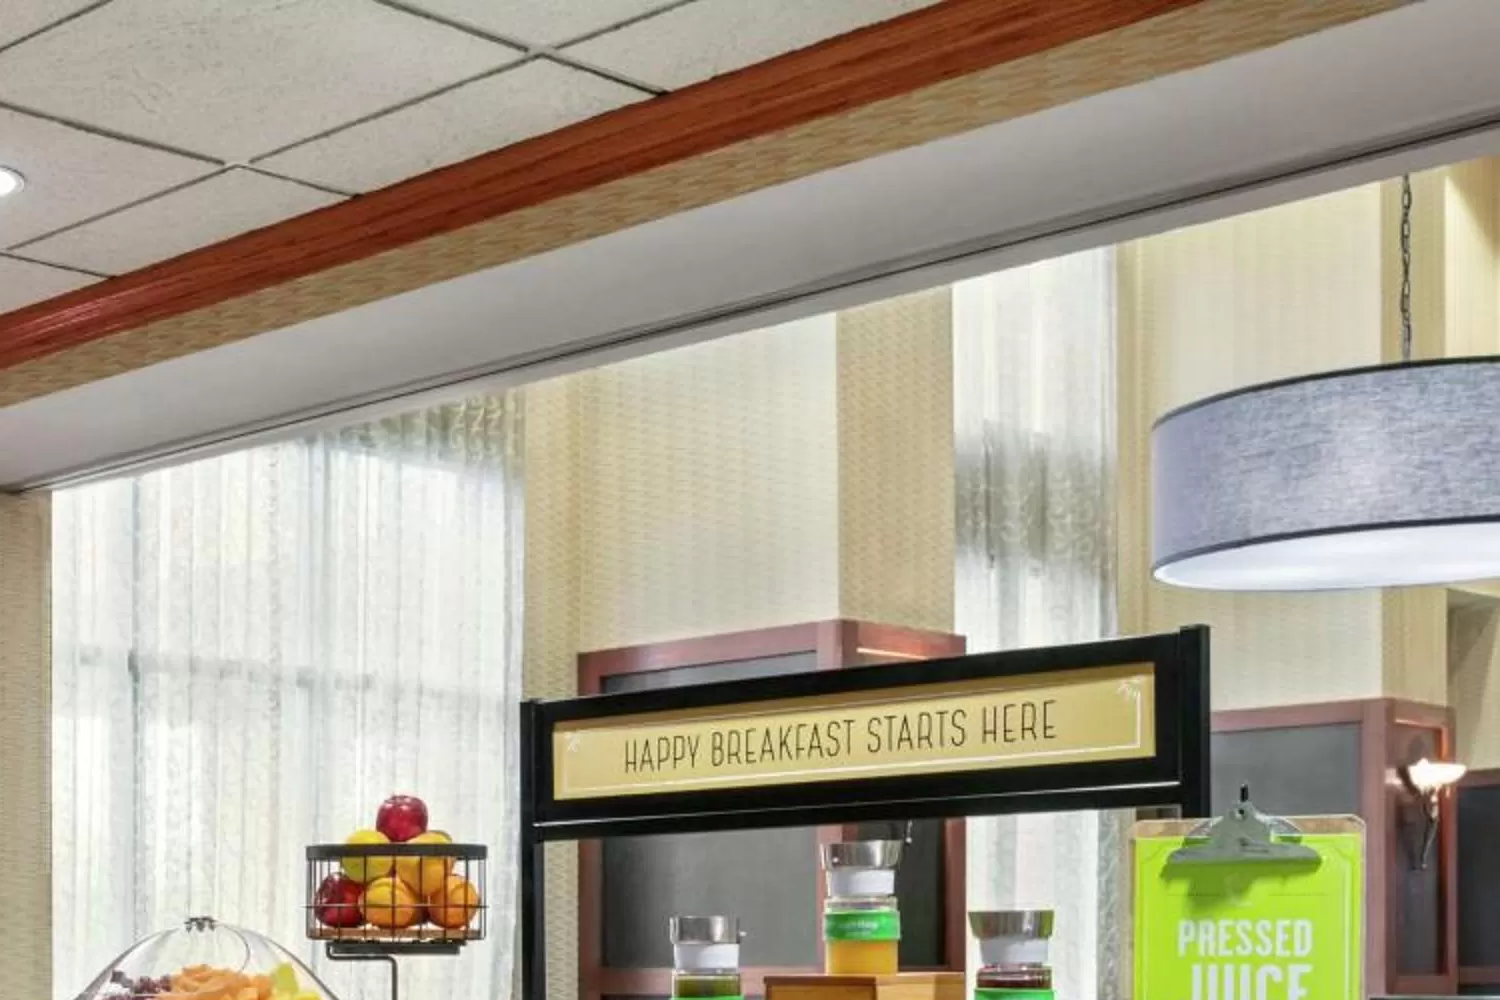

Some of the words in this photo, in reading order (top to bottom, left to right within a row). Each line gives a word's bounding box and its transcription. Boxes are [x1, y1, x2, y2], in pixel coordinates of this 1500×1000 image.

[624, 735, 700, 773] HAPPY
[710, 719, 855, 767] BREAKFAST
[866, 708, 967, 753] STARTS
[981, 699, 1057, 744] HERE
[1176, 919, 1313, 957] PRESSED
